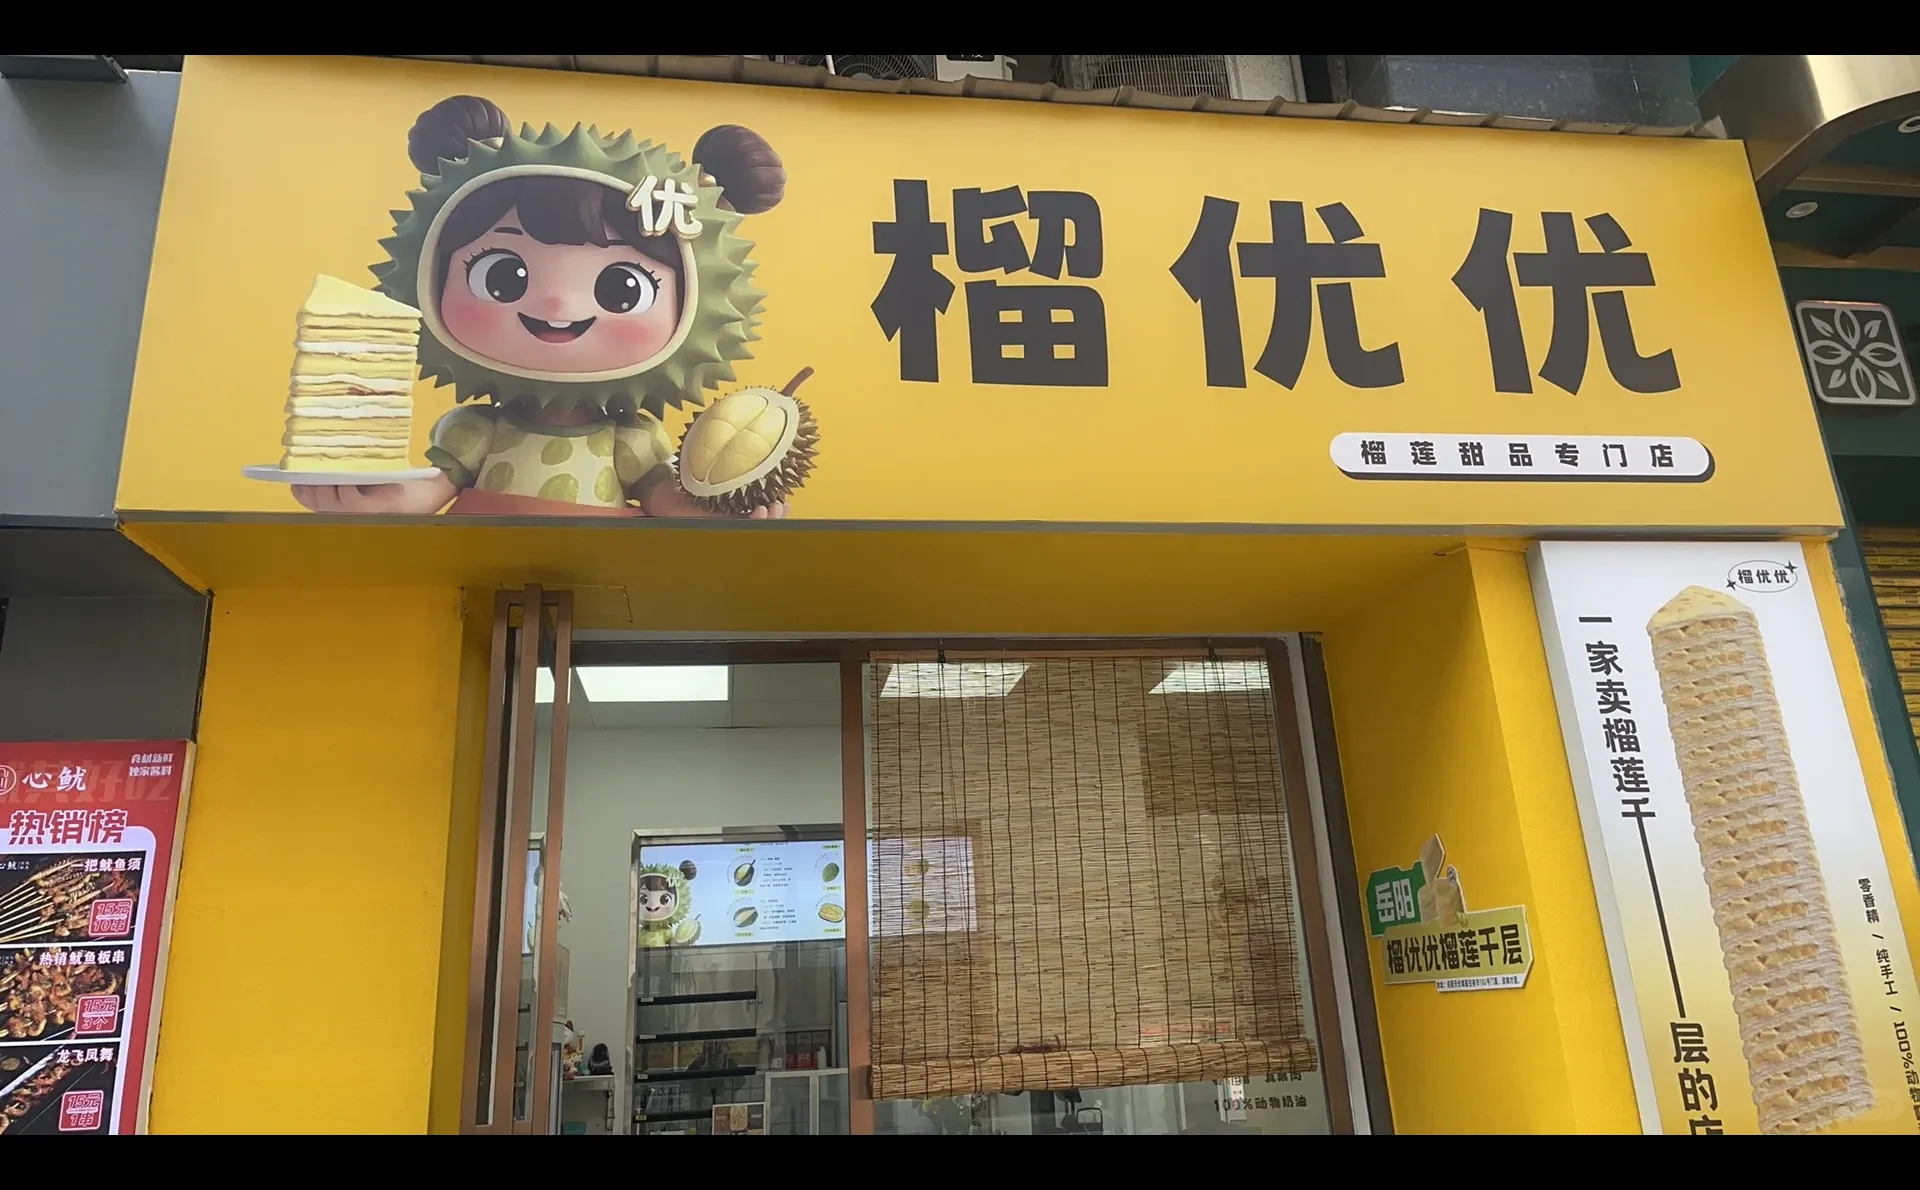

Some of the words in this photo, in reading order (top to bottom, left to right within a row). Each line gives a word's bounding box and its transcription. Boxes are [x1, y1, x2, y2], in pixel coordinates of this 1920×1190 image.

[626, 175, 703, 240] 优
[870, 178, 1681, 396] 榴优优
[1360, 440, 1675, 469] 榴莲甜品专门店
[1737, 569, 1790, 584] 榴优优
[22, 766, 87, 792] 心鱿
[8, 809, 129, 846] 热销榜
[71, 858, 142, 872] 一把鱿鱼须
[97, 902, 131, 915] 15元
[1375, 878, 1416, 923] 岳阳
[93, 920, 125, 933] 10串
[1858, 878, 1880, 923] 零香精
[1876, 948, 1898, 995] 纯手工
[1386, 923, 1523, 975] 榴优优榴莲千层
[39, 950, 125, 966] 热销鱿鱼板串
[84, 1000, 117, 1013] 15元
[82, 1017, 108, 1030] 3个
[56, 1047, 114, 1063] 龙飞凤舞
[68, 1094, 101, 1108] 15元
[1213, 1095, 1307, 1112] 100%动物奶油
[70, 1113, 94, 1127] 1串
